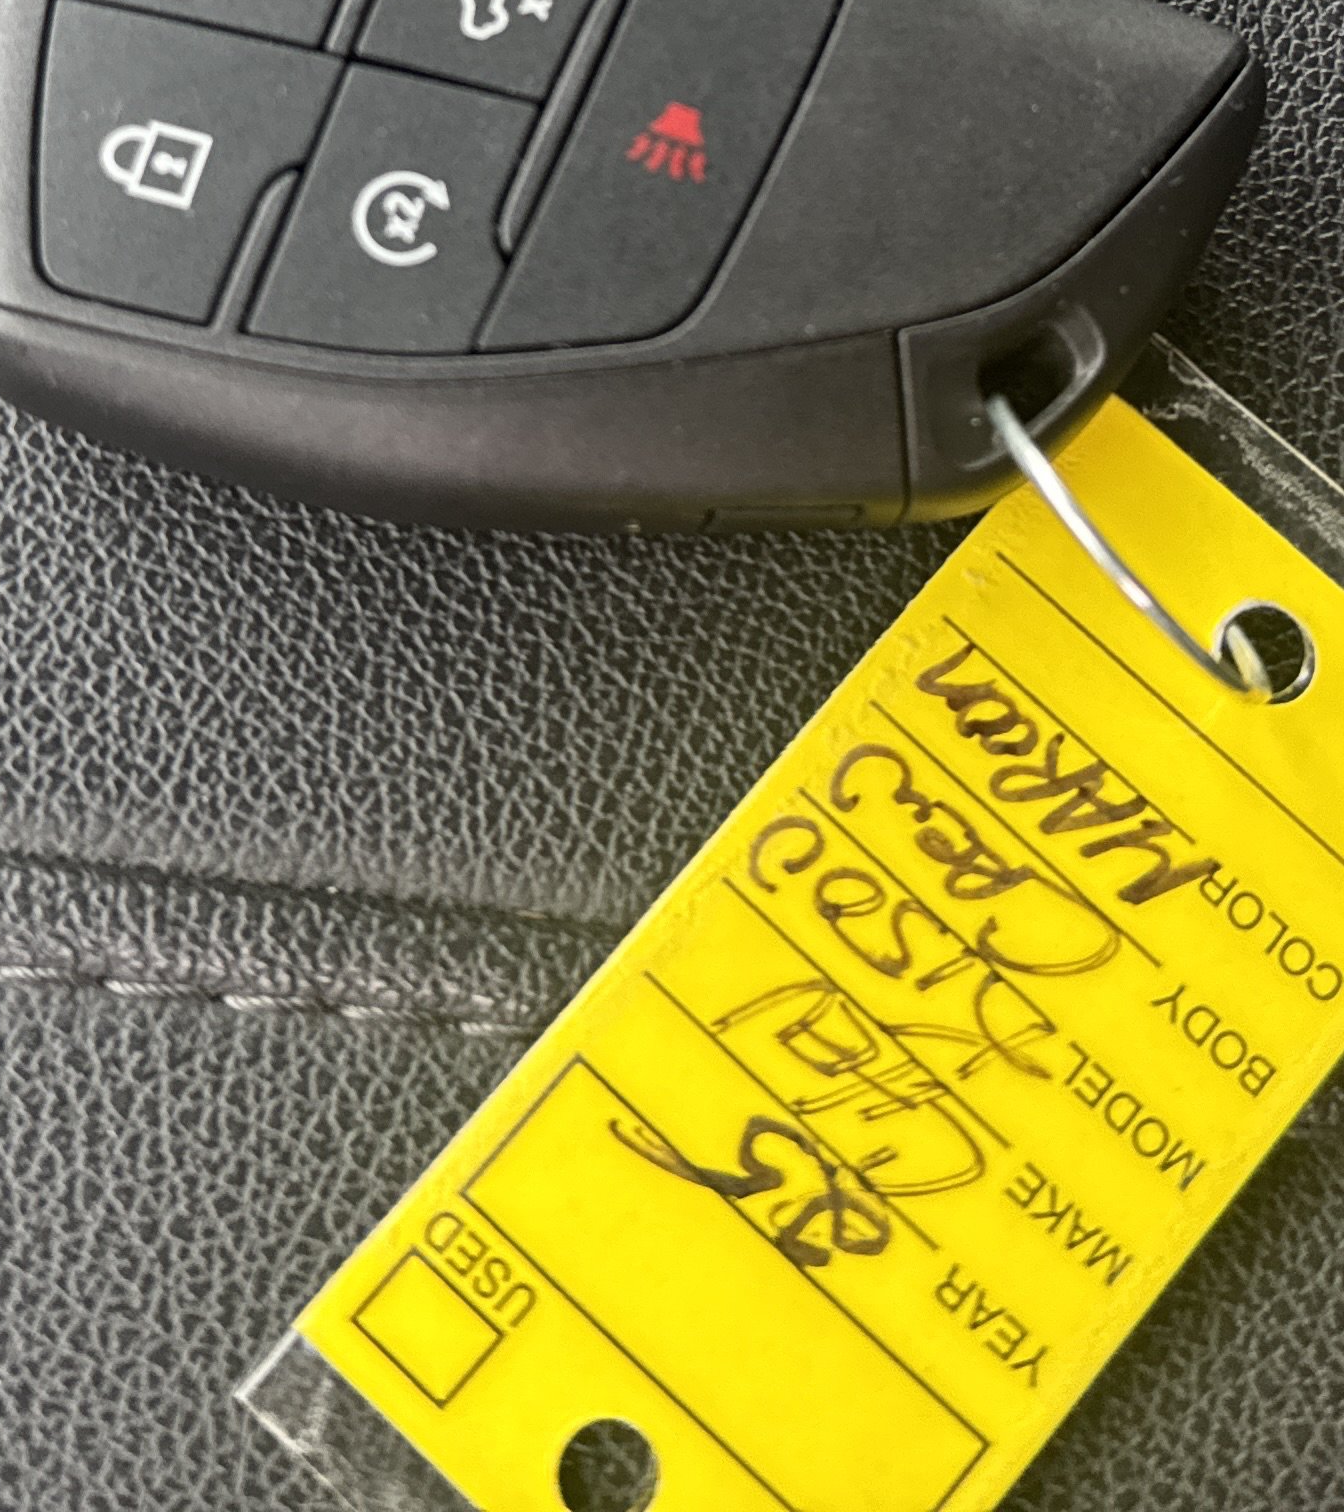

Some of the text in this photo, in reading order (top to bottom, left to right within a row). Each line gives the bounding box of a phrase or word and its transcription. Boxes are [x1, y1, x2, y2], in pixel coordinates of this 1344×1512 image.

[1199, 864, 1343, 1003] COLOR
[1150, 983, 1277, 1098] BODY
[1065, 1041, 1208, 1191] MODEL
[608, 1114, 891, 1268] 25
[1005, 1162, 1132, 1289] MAKE
[424, 1212, 537, 1327] USED
[934, 1263, 1054, 1387] YEAR
